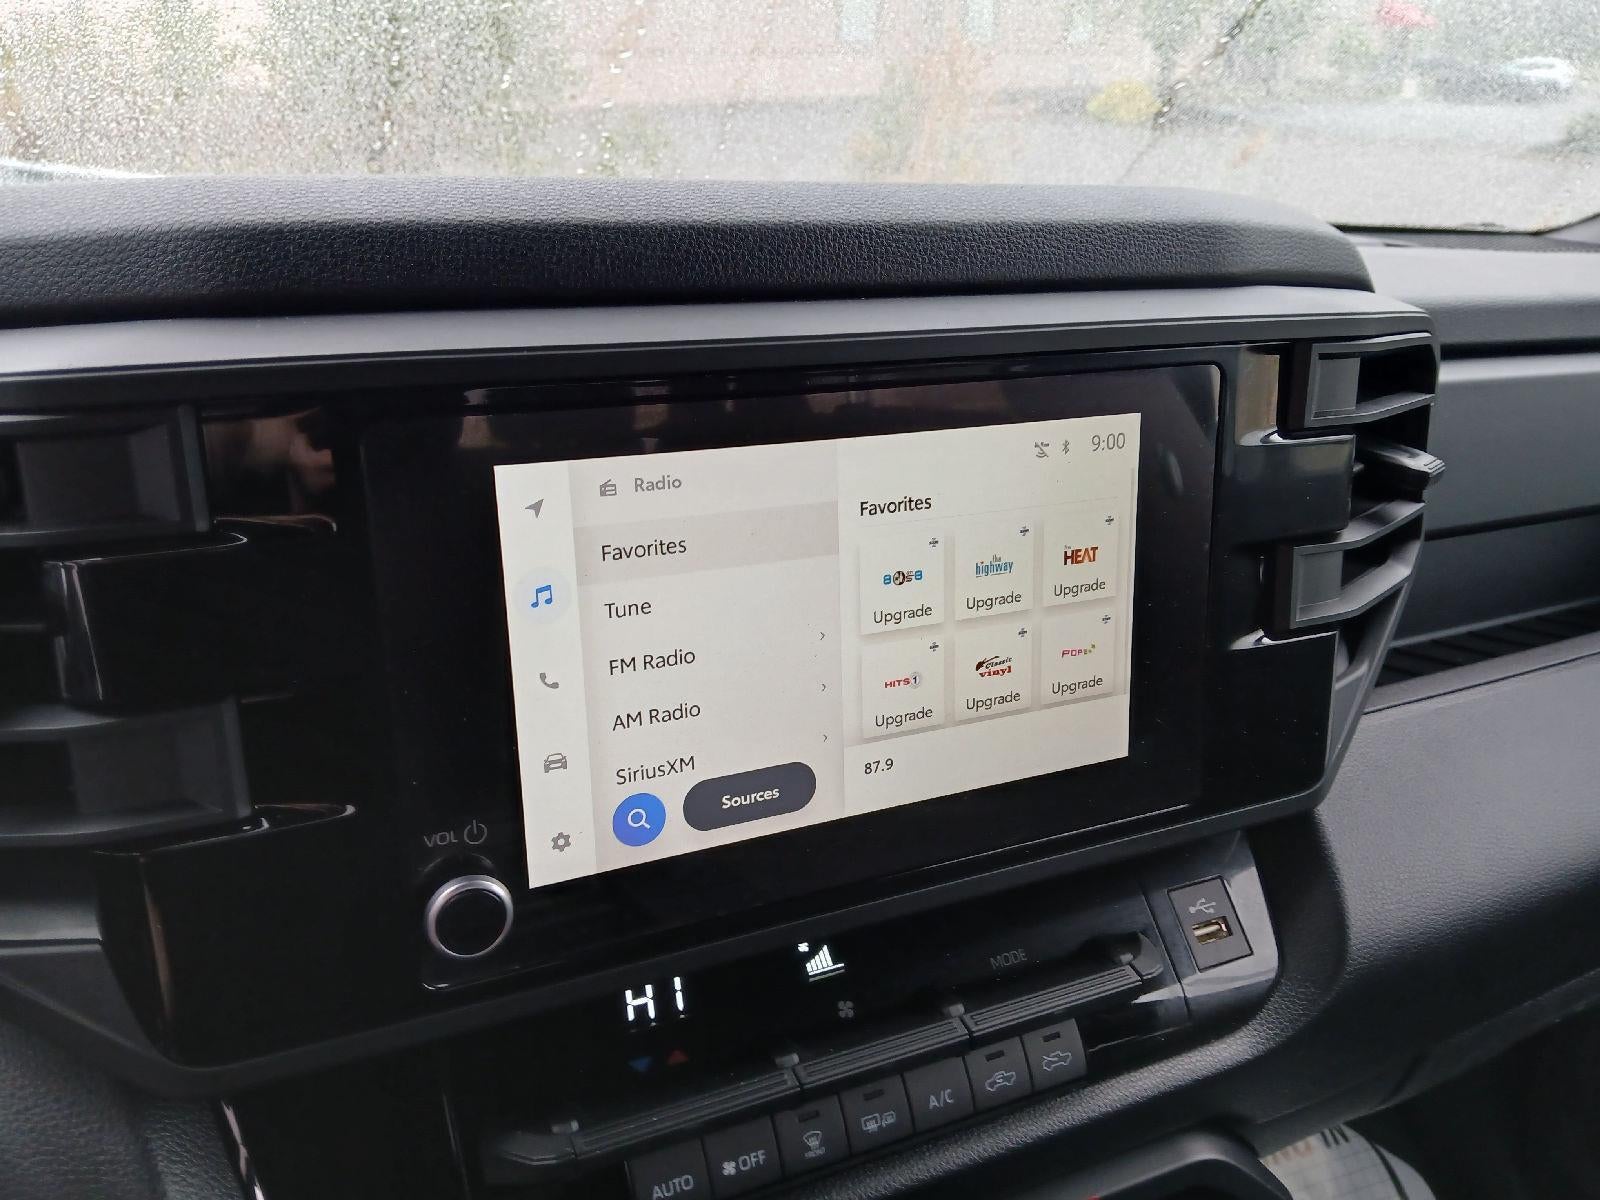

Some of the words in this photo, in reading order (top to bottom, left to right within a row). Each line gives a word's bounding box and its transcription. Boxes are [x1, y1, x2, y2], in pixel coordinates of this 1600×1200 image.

[1091, 432, 1126, 452] 9:00
[634, 475, 682, 493] Radio
[859, 496, 932, 516] Favorites
[601, 538, 687, 562] Favorites
[1063, 546, 1099, 566] HEAT
[975, 560, 1014, 577] highway
[1054, 577, 1106, 598] Upgrade
[604, 601, 652, 619] Tune
[966, 591, 1022, 611] Upgrade
[873, 604, 933, 625] Upgrade
[609, 656, 637, 676] FM
[643, 648, 696, 671] Radio
[979, 665, 1012, 678] vinyl
[1052, 675, 1103, 696] Upgrade
[966, 690, 1021, 712] Upgrade
[612, 710, 643, 731] AM
[648, 703, 701, 725] Radio
[875, 706, 933, 729] Upgrade
[616, 756, 696, 785] SiriusXM
[864, 758, 894, 775] 87.9
[721, 788, 780, 809] Sources
[423, 831, 459, 849] VOL
[990, 948, 1028, 970] MODE
[624, 976, 685, 1021] HI
[928, 1088, 955, 1110] A/C
[738, 1149, 767, 1171] OFF
[652, 1174, 694, 1200] AUTO
